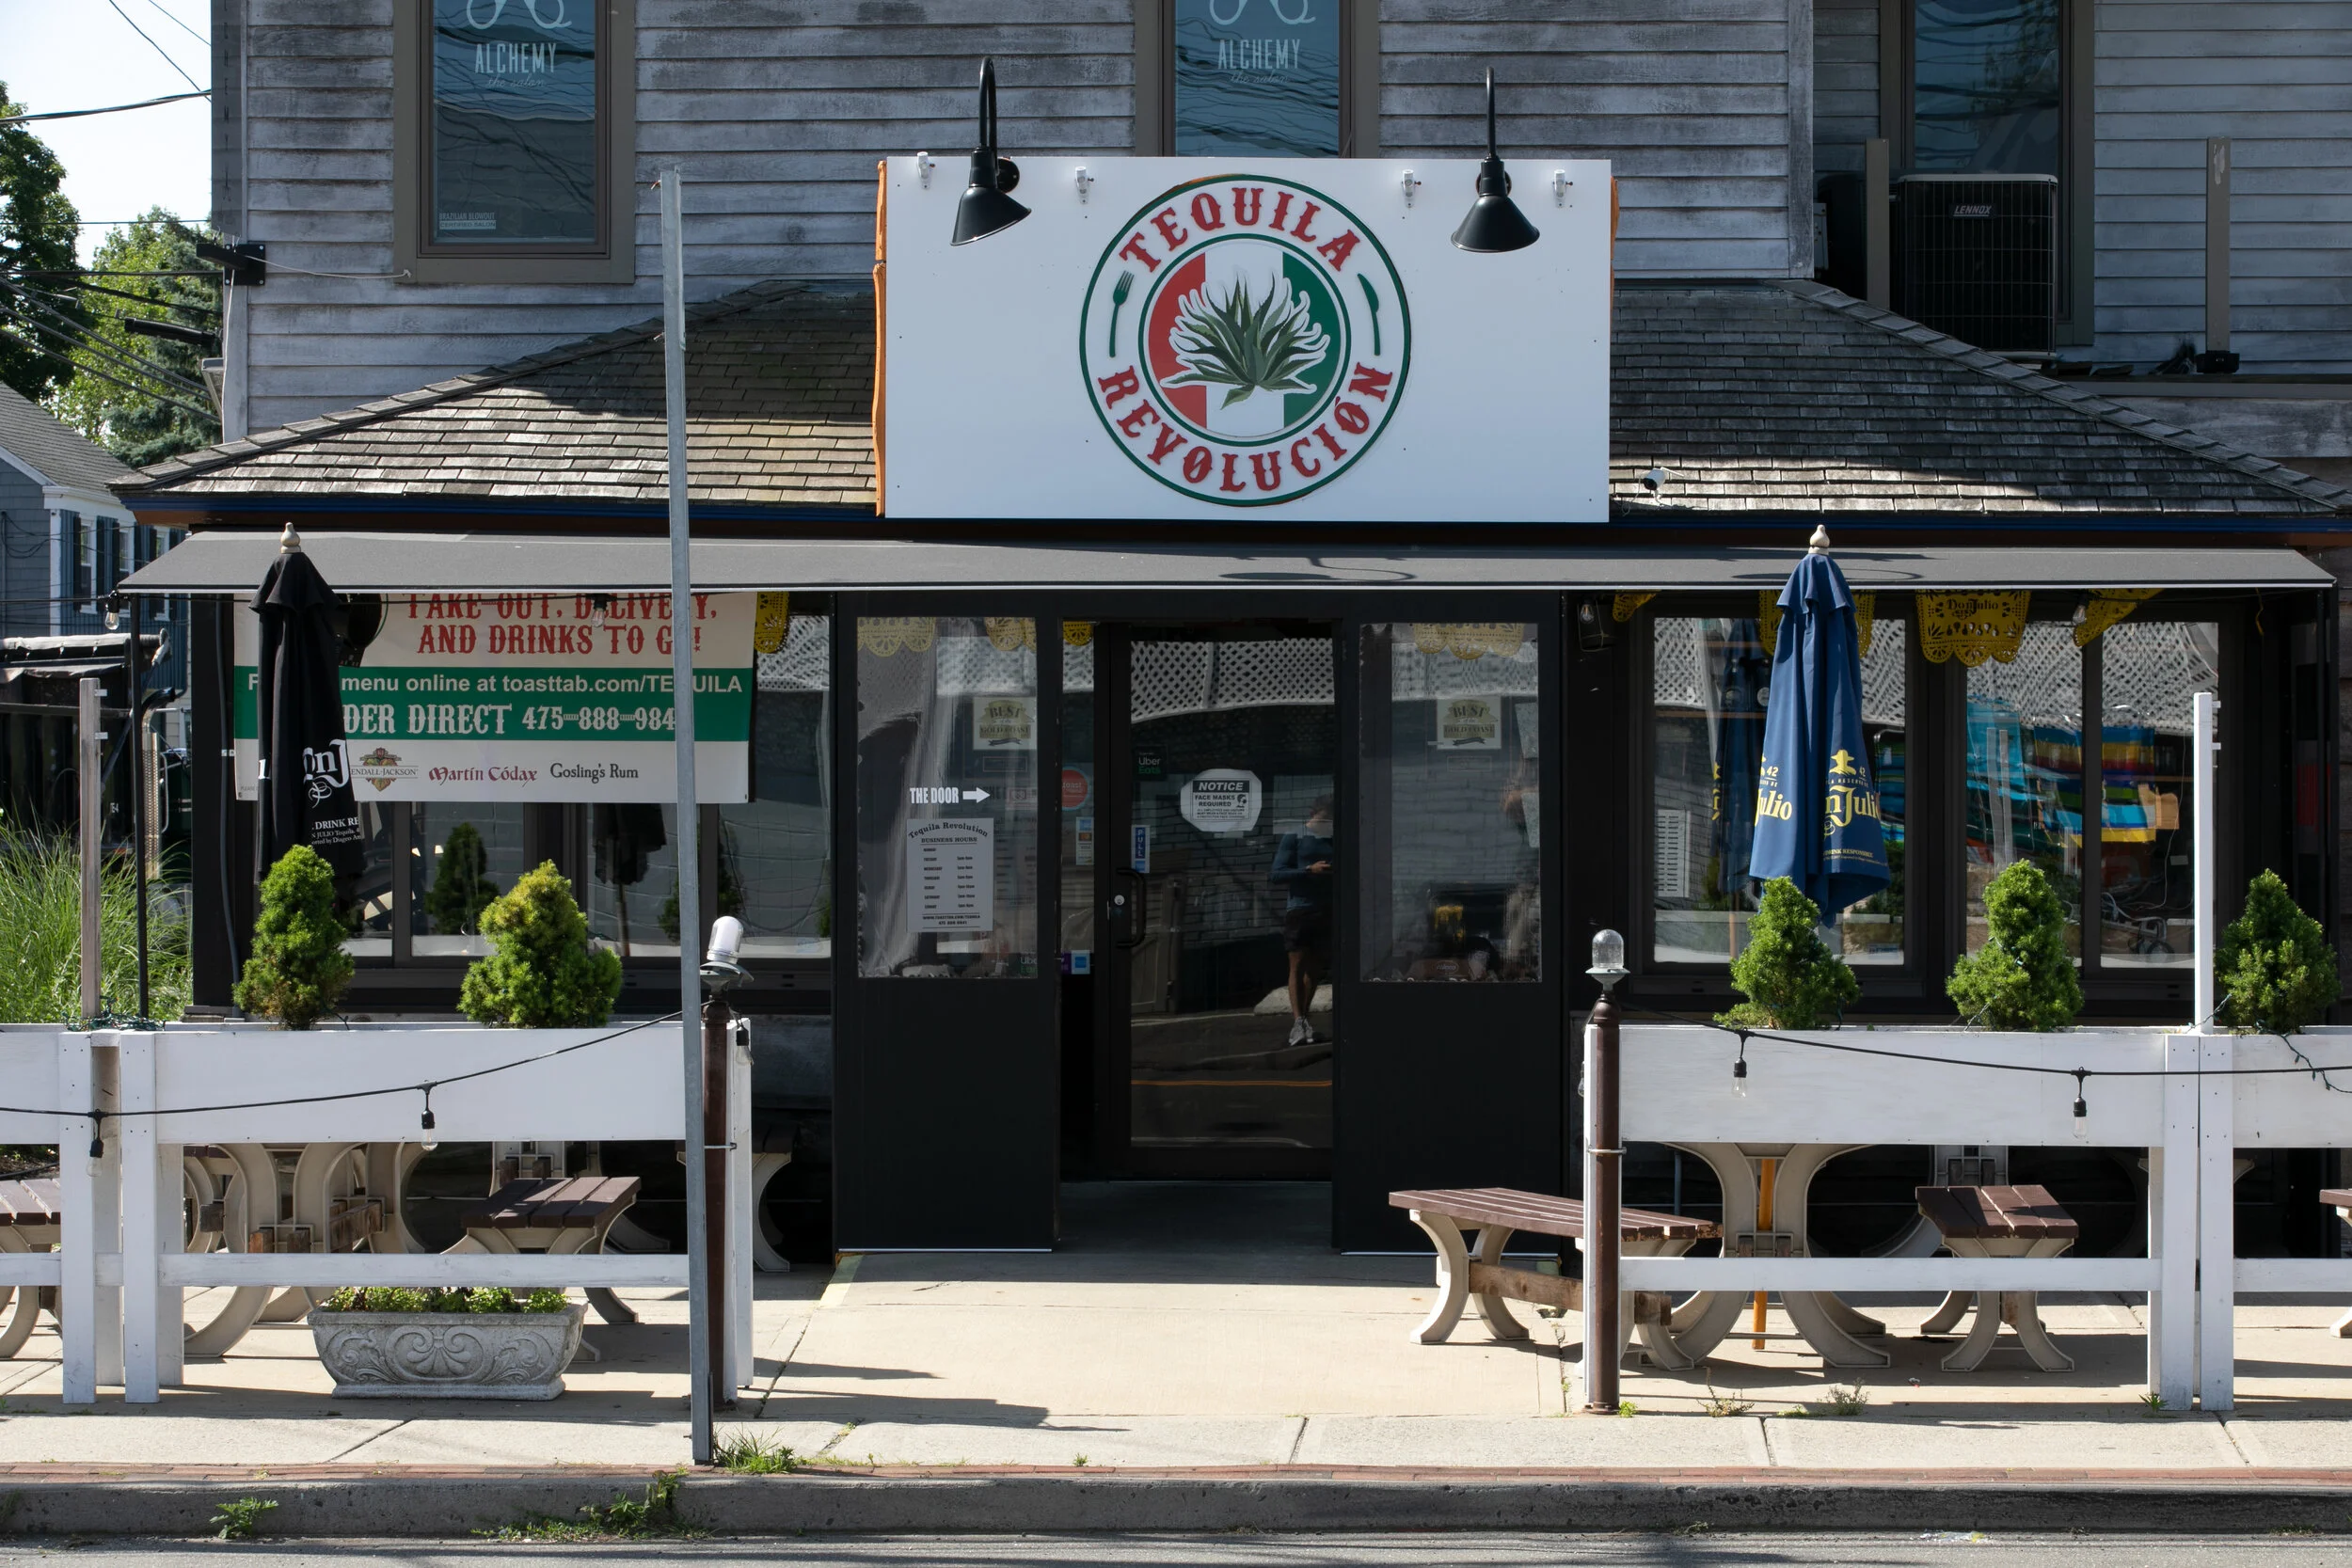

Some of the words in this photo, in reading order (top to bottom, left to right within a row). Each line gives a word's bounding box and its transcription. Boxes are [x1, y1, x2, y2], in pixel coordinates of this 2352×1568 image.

[474, 42, 558, 74] ALCHEMY
[1218, 39, 1300, 70] ALCHEMY
[486, 74, 506, 87] the
[509, 73, 547, 87] salon
[1954, 205, 1992, 214] LENNOX
[1119, 187, 1361, 273] TEQUILA
[574, 594, 717, 619] DLIVEY,
[417, 625, 477, 654] AND
[487, 625, 593, 655] DRINKS
[603, 624, 644, 655] TO
[656, 625, 702, 655] G!
[342, 677, 399, 691] menu
[405, 674, 470, 691] online
[477, 675, 497, 691] at
[502, 674, 742, 692] toasttab.com/TEUILA
[342, 704, 396, 734] DER
[406, 704, 512, 735] DIRECT
[522, 705, 675, 731] 475-888-984
[990, 706, 1020, 719] BEST
[1454, 705, 1485, 718] BEST
[1138, 755, 1161, 766] Uber
[351, 768, 416, 776] ENDALL-JACKSON
[487, 766, 538, 787] Códax
[549, 762, 606, 784] Gosling's
[610, 764, 639, 778] Rum
[1138, 766, 1161, 774] Eats
[1766, 766, 1778, 777] 42
[1859, 766, 1867, 777] 42
[1199, 782, 1244, 791] NOTICE
[910, 787, 929, 804] THE
[930, 786, 959, 804] DOOR
[315, 819, 346, 830] DRINK
[908, 823, 940, 839] Tequila
[943, 821, 988, 837] Revolution
